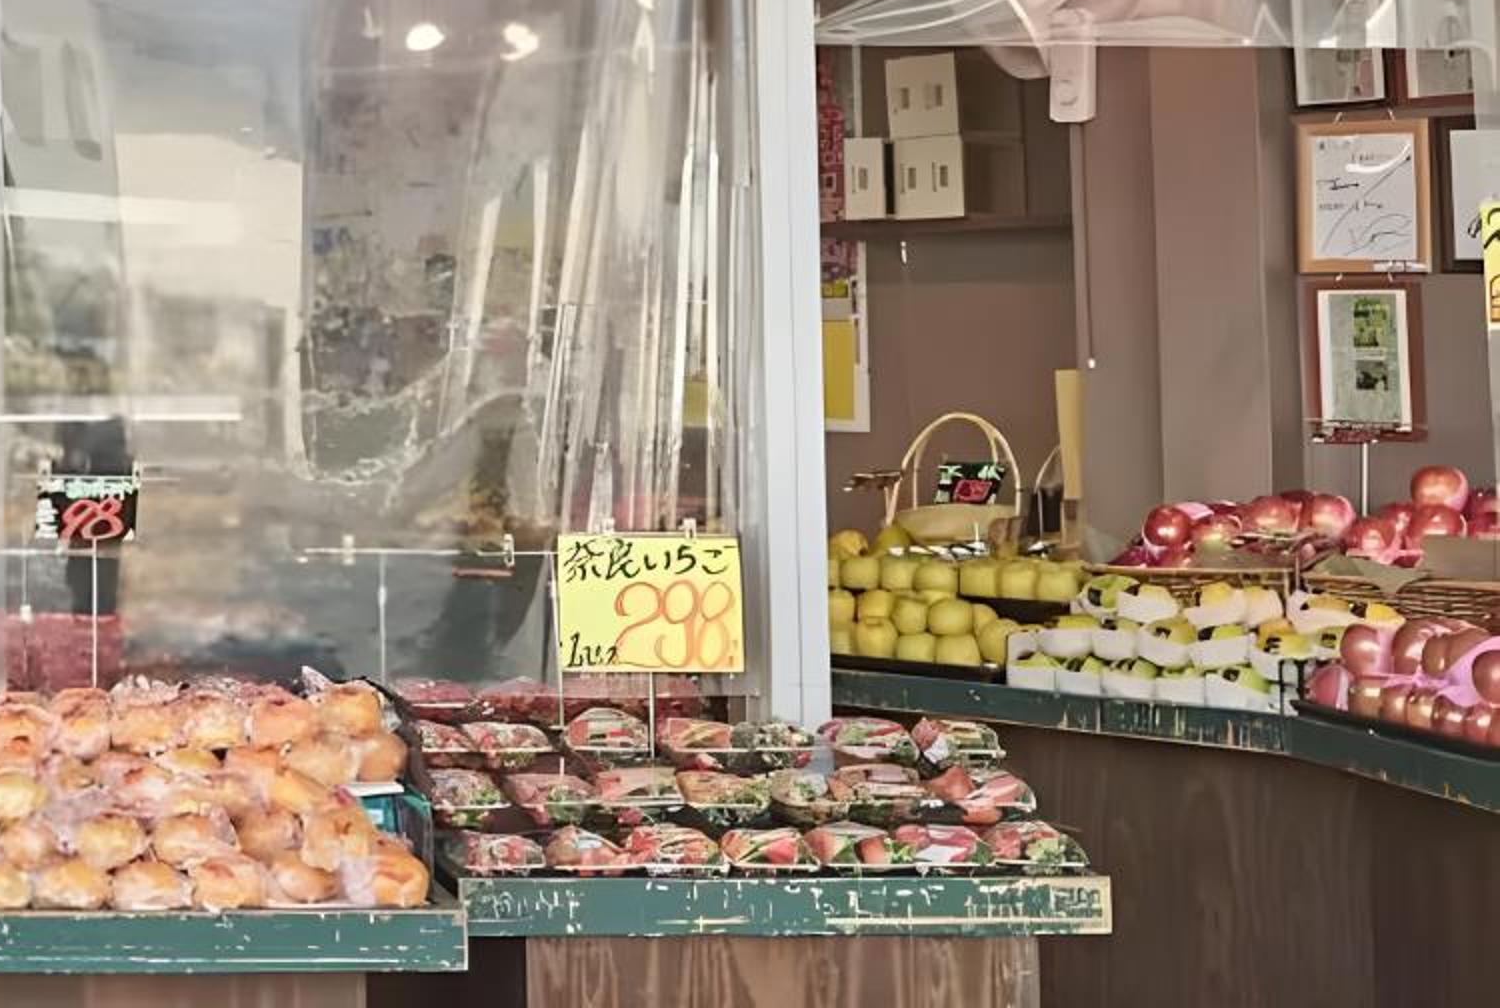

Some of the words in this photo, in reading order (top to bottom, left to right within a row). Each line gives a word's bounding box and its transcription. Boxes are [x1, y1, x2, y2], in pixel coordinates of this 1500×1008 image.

[563, 537, 738, 583] 奈良いちご
[614, 579, 736, 669] 298
